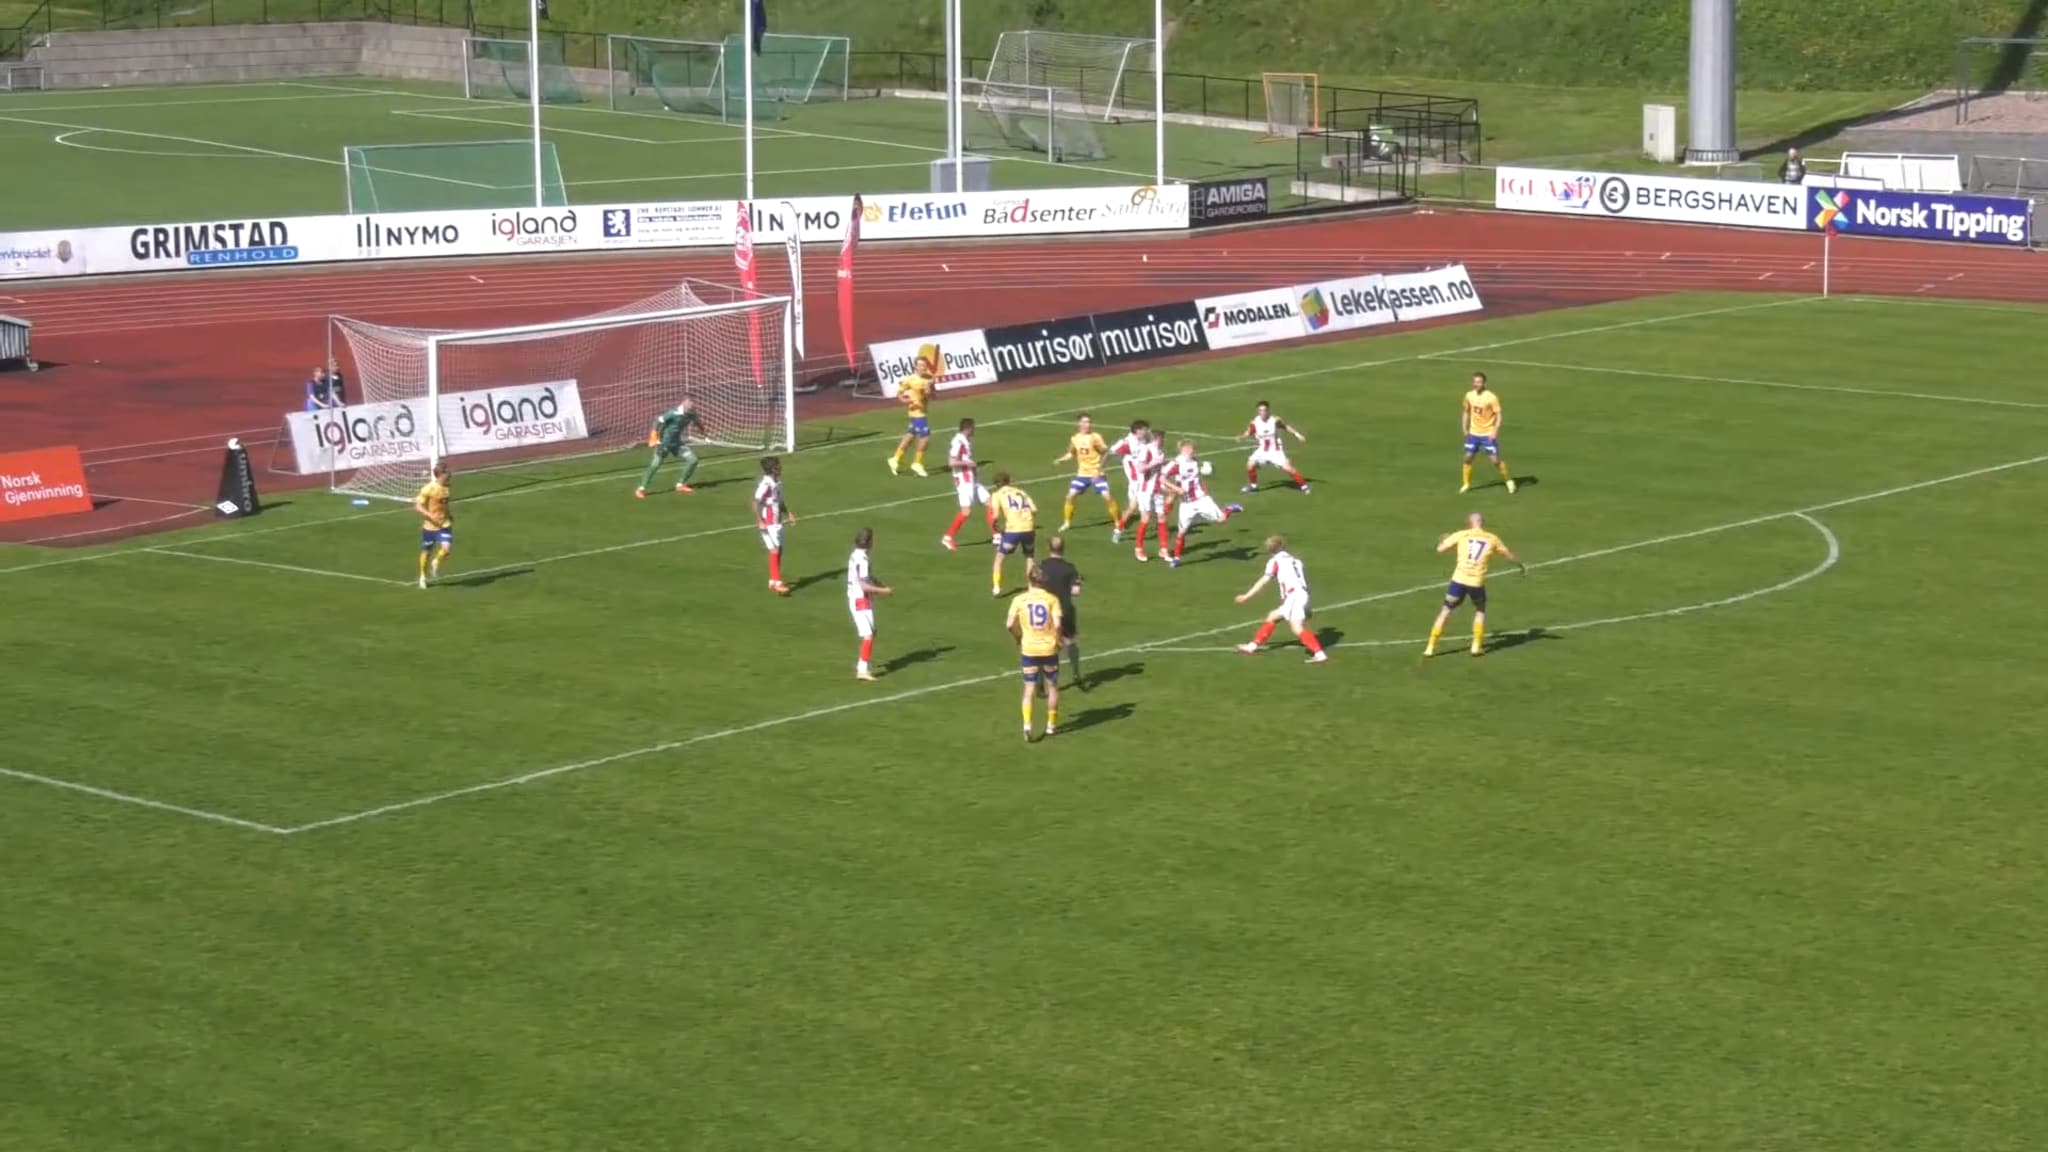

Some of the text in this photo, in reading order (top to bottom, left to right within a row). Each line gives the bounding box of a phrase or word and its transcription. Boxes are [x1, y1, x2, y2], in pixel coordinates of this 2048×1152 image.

[1207, 182, 1265, 205] AMIGA
[1636, 187, 1798, 215] BERGSHAVEN
[888, 202, 967, 222] EleFun
[983, 198, 1097, 224] Bådsenter
[1856, 198, 2025, 241] Norsk Tipping
[386, 224, 459, 246] NYMO
[492, 210, 577, 241] igland
[130, 221, 289, 260] GRIMSTAD
[516, 234, 578, 246] GARASJEN
[190, 249, 296, 263] RENHOLD
[1223, 303, 1292, 327] MODALEN
[1100, 315, 1199, 357] murisør
[944, 347, 989, 370] Punkt
[993, 329, 1095, 373] murisør
[460, 387, 558, 435] igland
[495, 421, 563, 441] GARASJEN
[1, 471, 42, 488] Norsk
[4, 483, 84, 506] Gjenvinning
[1008, 492, 1031, 510] 42
[1027, 604, 1048, 626] 19
